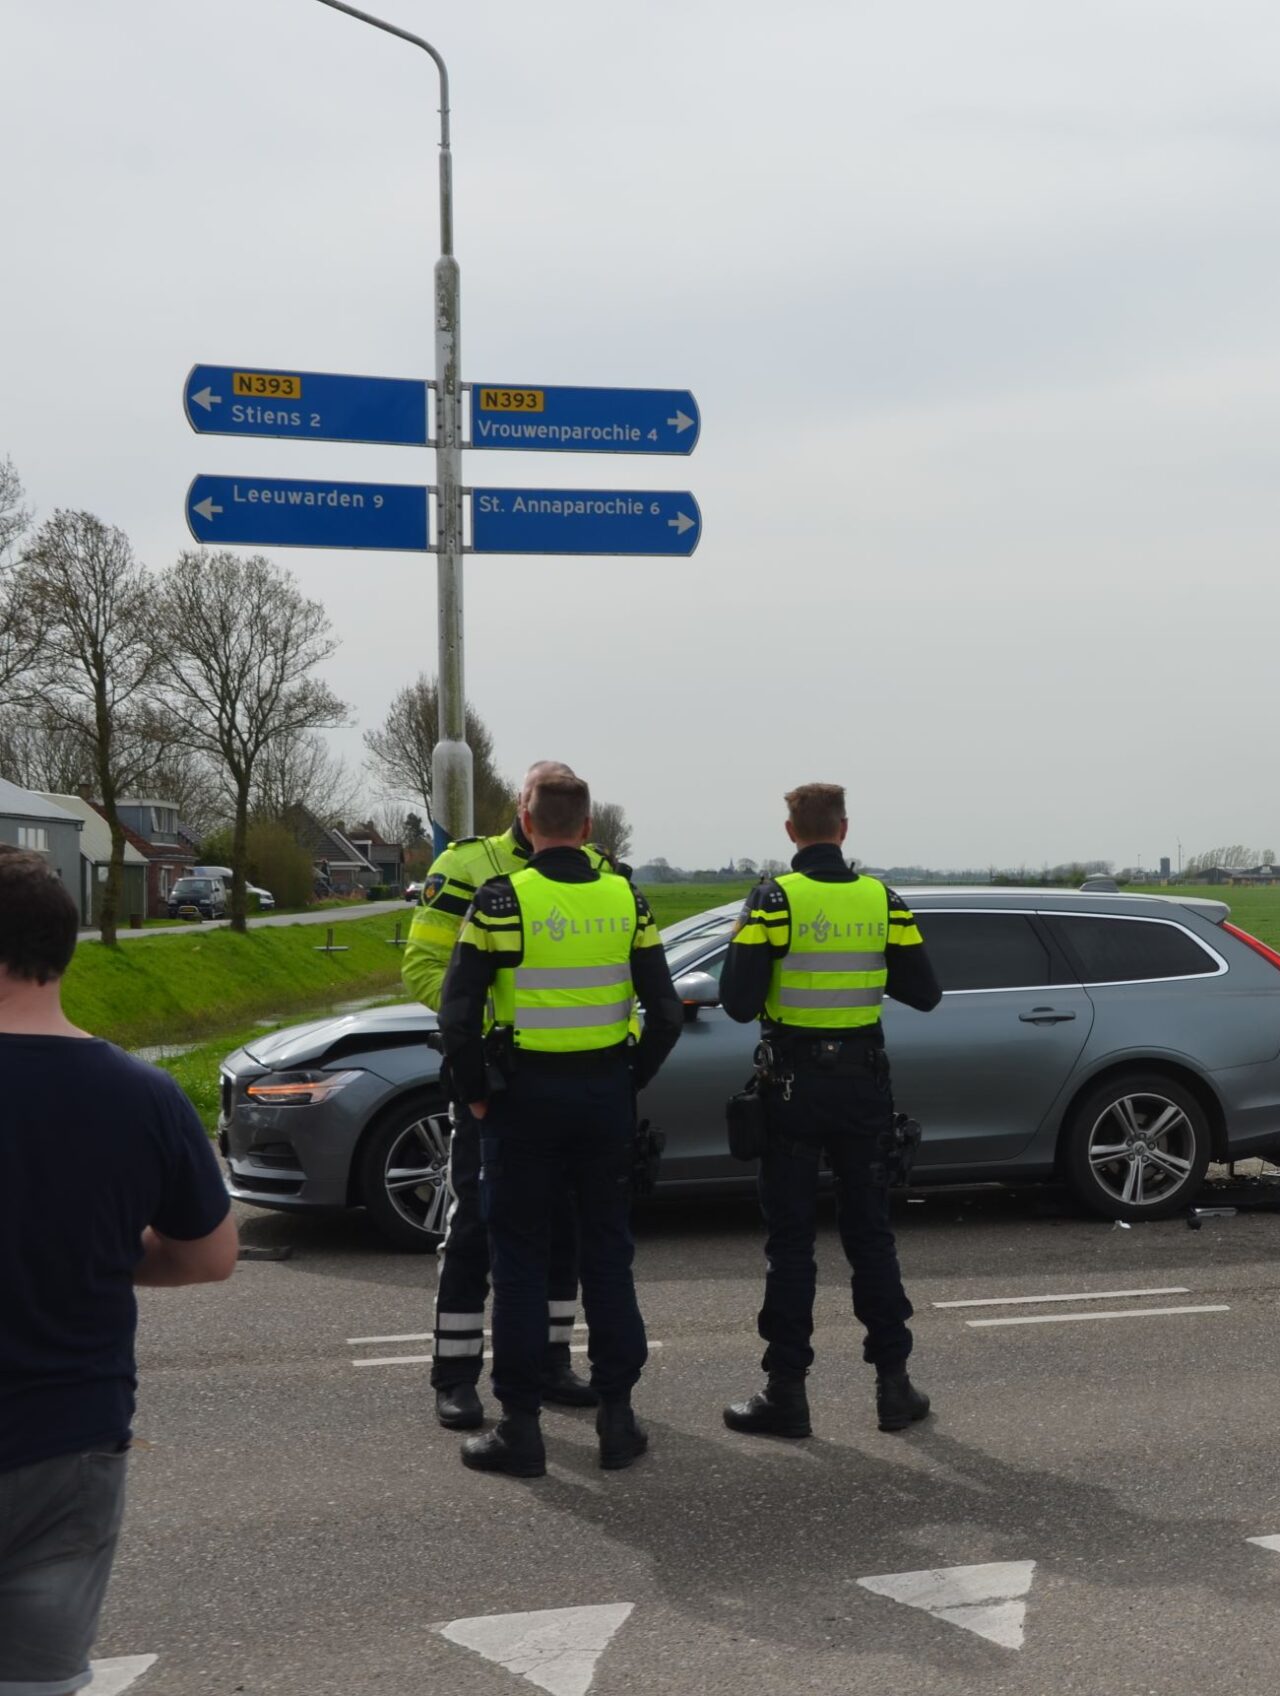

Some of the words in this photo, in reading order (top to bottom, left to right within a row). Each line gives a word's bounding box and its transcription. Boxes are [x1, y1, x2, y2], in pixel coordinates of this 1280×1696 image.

[238, 376, 295, 395] N393
[485, 391, 538, 409] N393
[231, 404, 301, 426] Stiens
[309, 413, 322, 428] 2
[478, 420, 642, 442] Vrouwenparochie
[647, 429, 659, 442] 4
[232, 484, 365, 508] Leeuwarden
[373, 494, 385, 509] 9
[479, 495, 506, 513] St.
[512, 496, 644, 517] Annaparochie
[649, 501, 661, 515] 6
